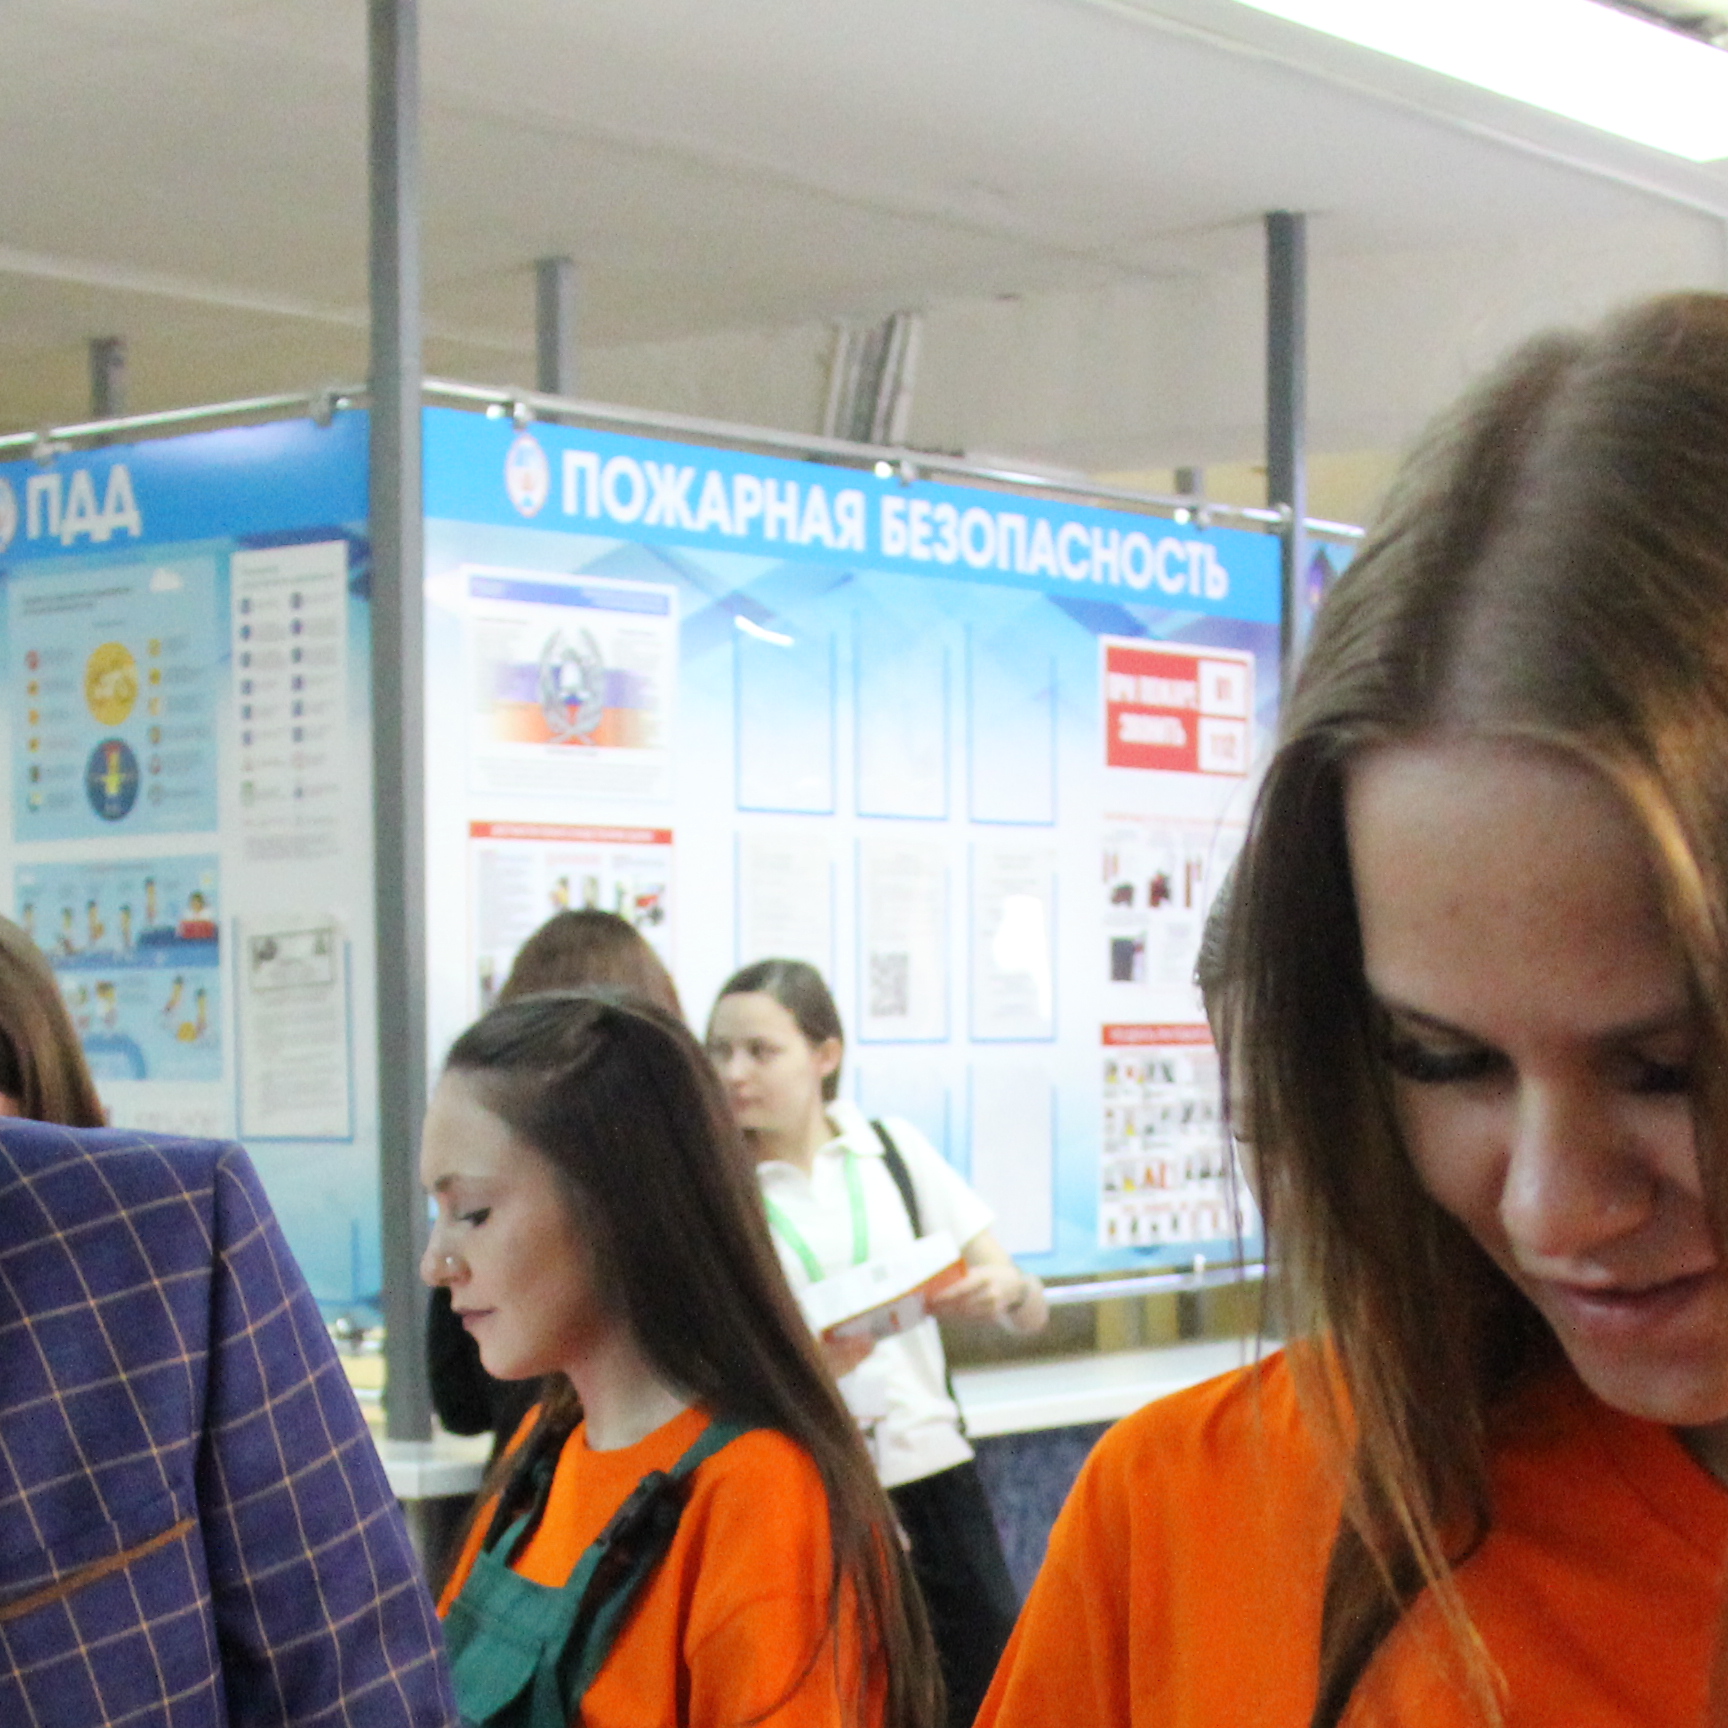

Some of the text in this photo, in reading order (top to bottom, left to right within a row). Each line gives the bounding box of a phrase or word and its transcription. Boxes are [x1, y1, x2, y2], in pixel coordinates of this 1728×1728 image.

[26, 463, 142, 547] ПДД
[561, 448, 1231, 601] ПОЖАРНАЯ БЕЗОПАСНОСТЬ
